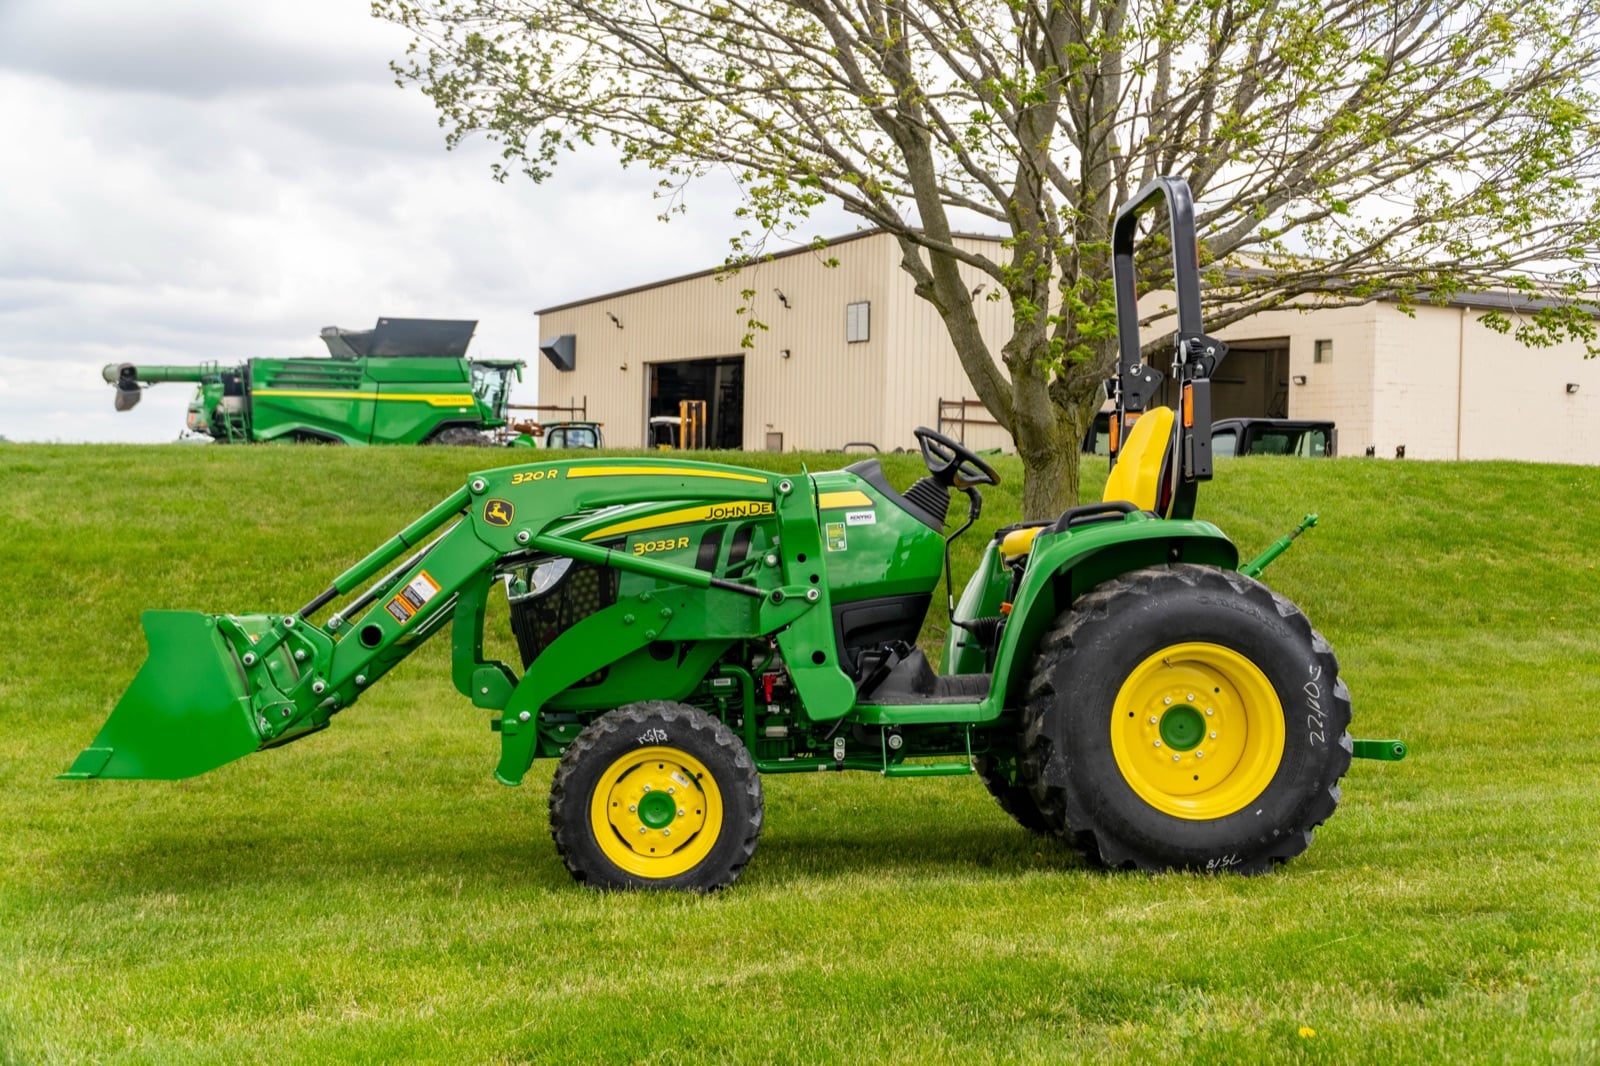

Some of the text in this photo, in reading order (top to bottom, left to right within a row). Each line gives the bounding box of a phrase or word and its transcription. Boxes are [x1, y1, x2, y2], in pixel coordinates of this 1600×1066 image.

[511, 469, 559, 485] 320 R
[704, 506, 747, 520] JOHN
[632, 536, 690, 556] 3033 R
